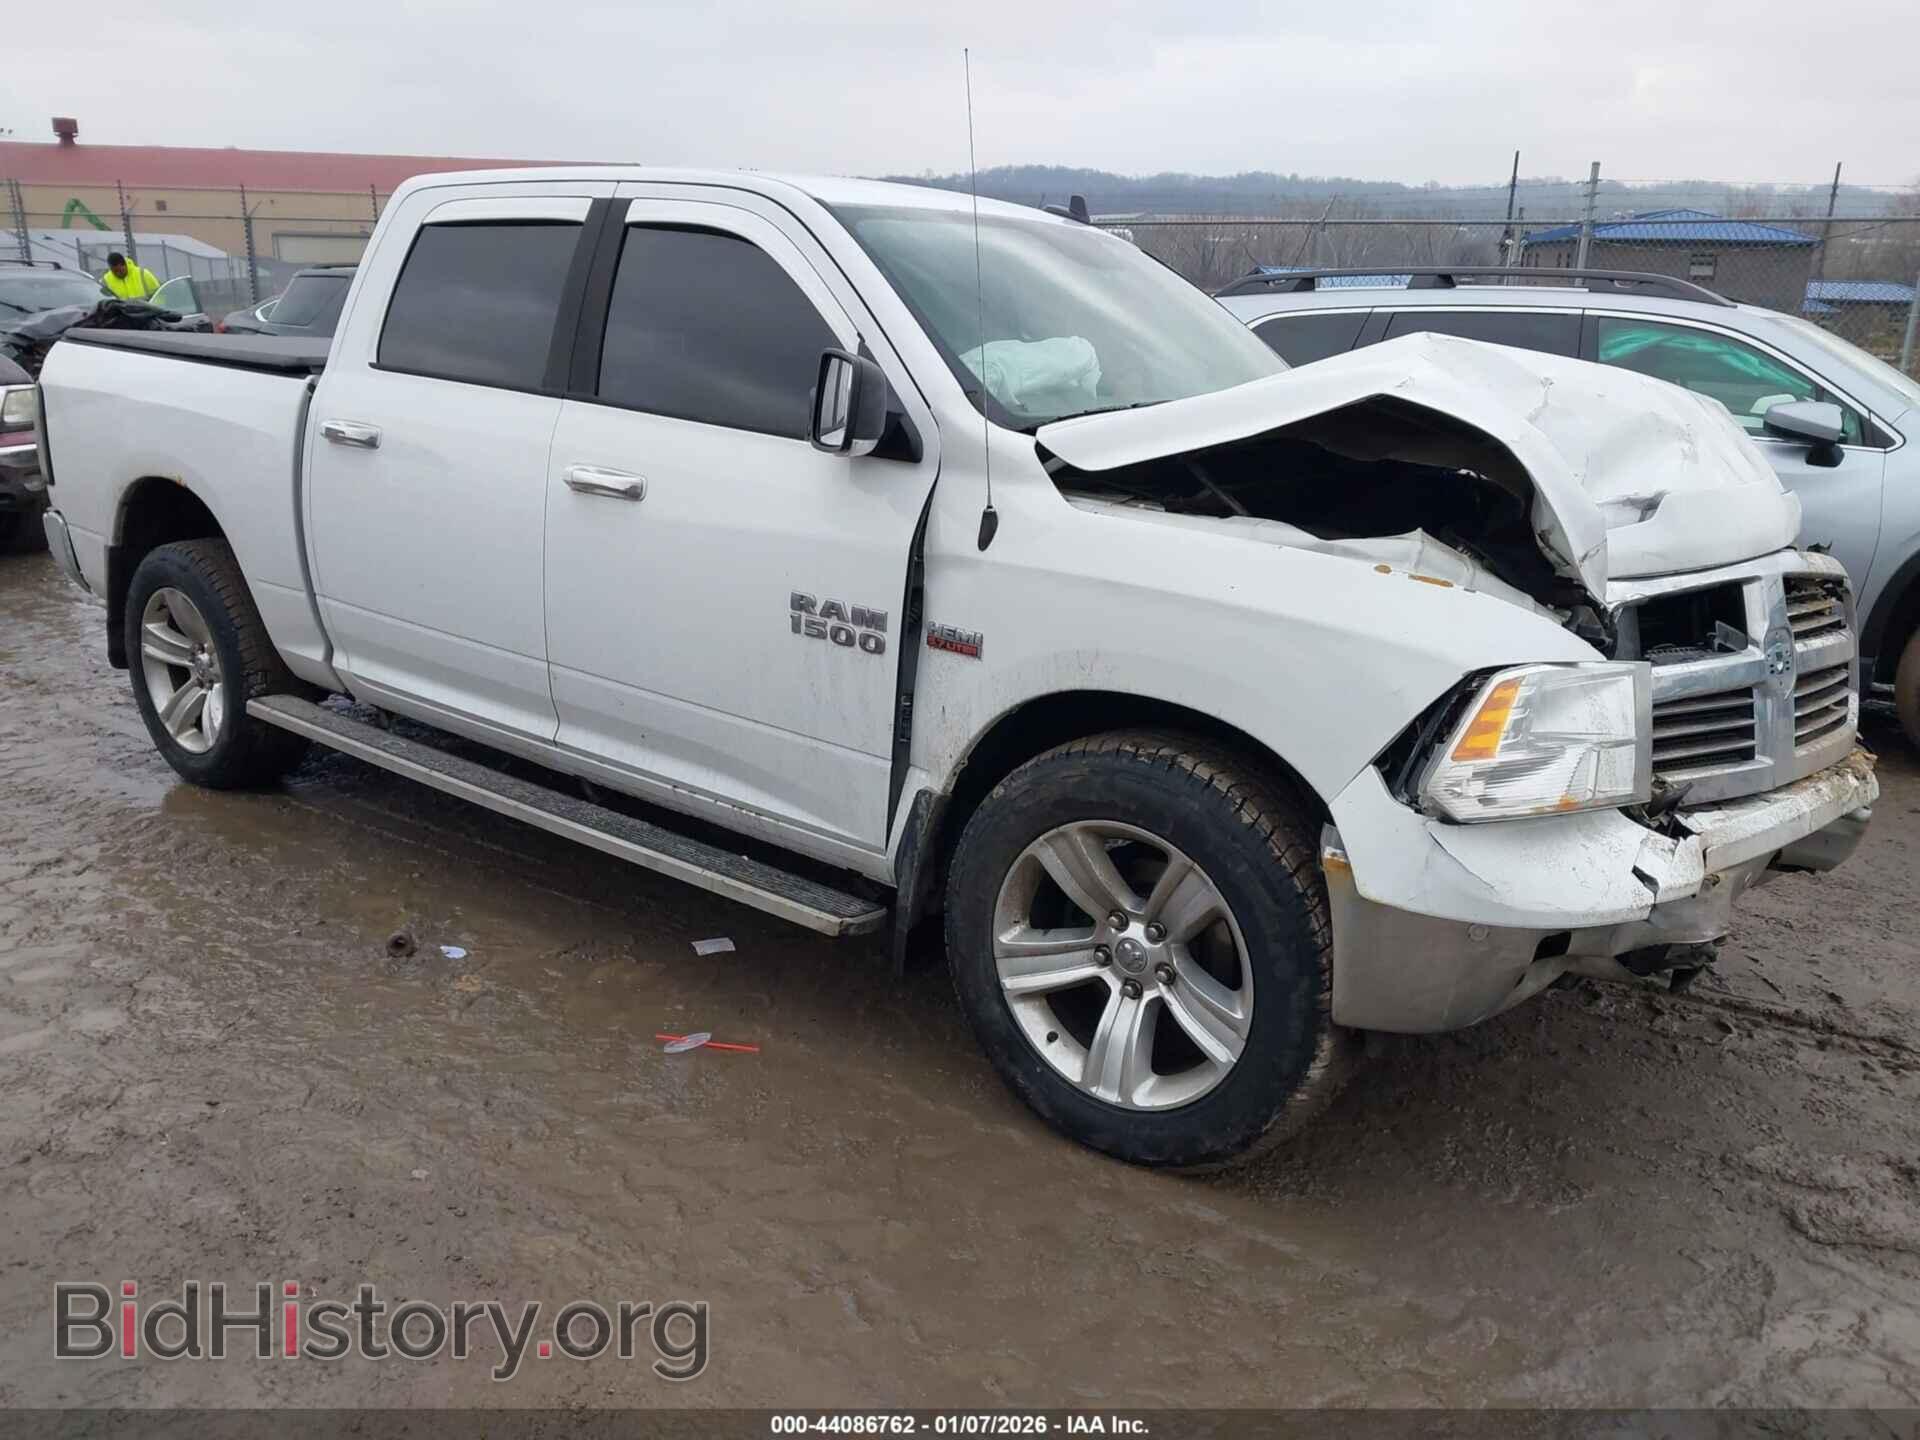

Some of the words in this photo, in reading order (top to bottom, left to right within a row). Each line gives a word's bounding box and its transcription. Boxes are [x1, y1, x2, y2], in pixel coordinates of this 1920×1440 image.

[790, 591, 888, 633] RAM
[927, 620, 983, 646] HEMI
[790, 613, 887, 655] 1500
